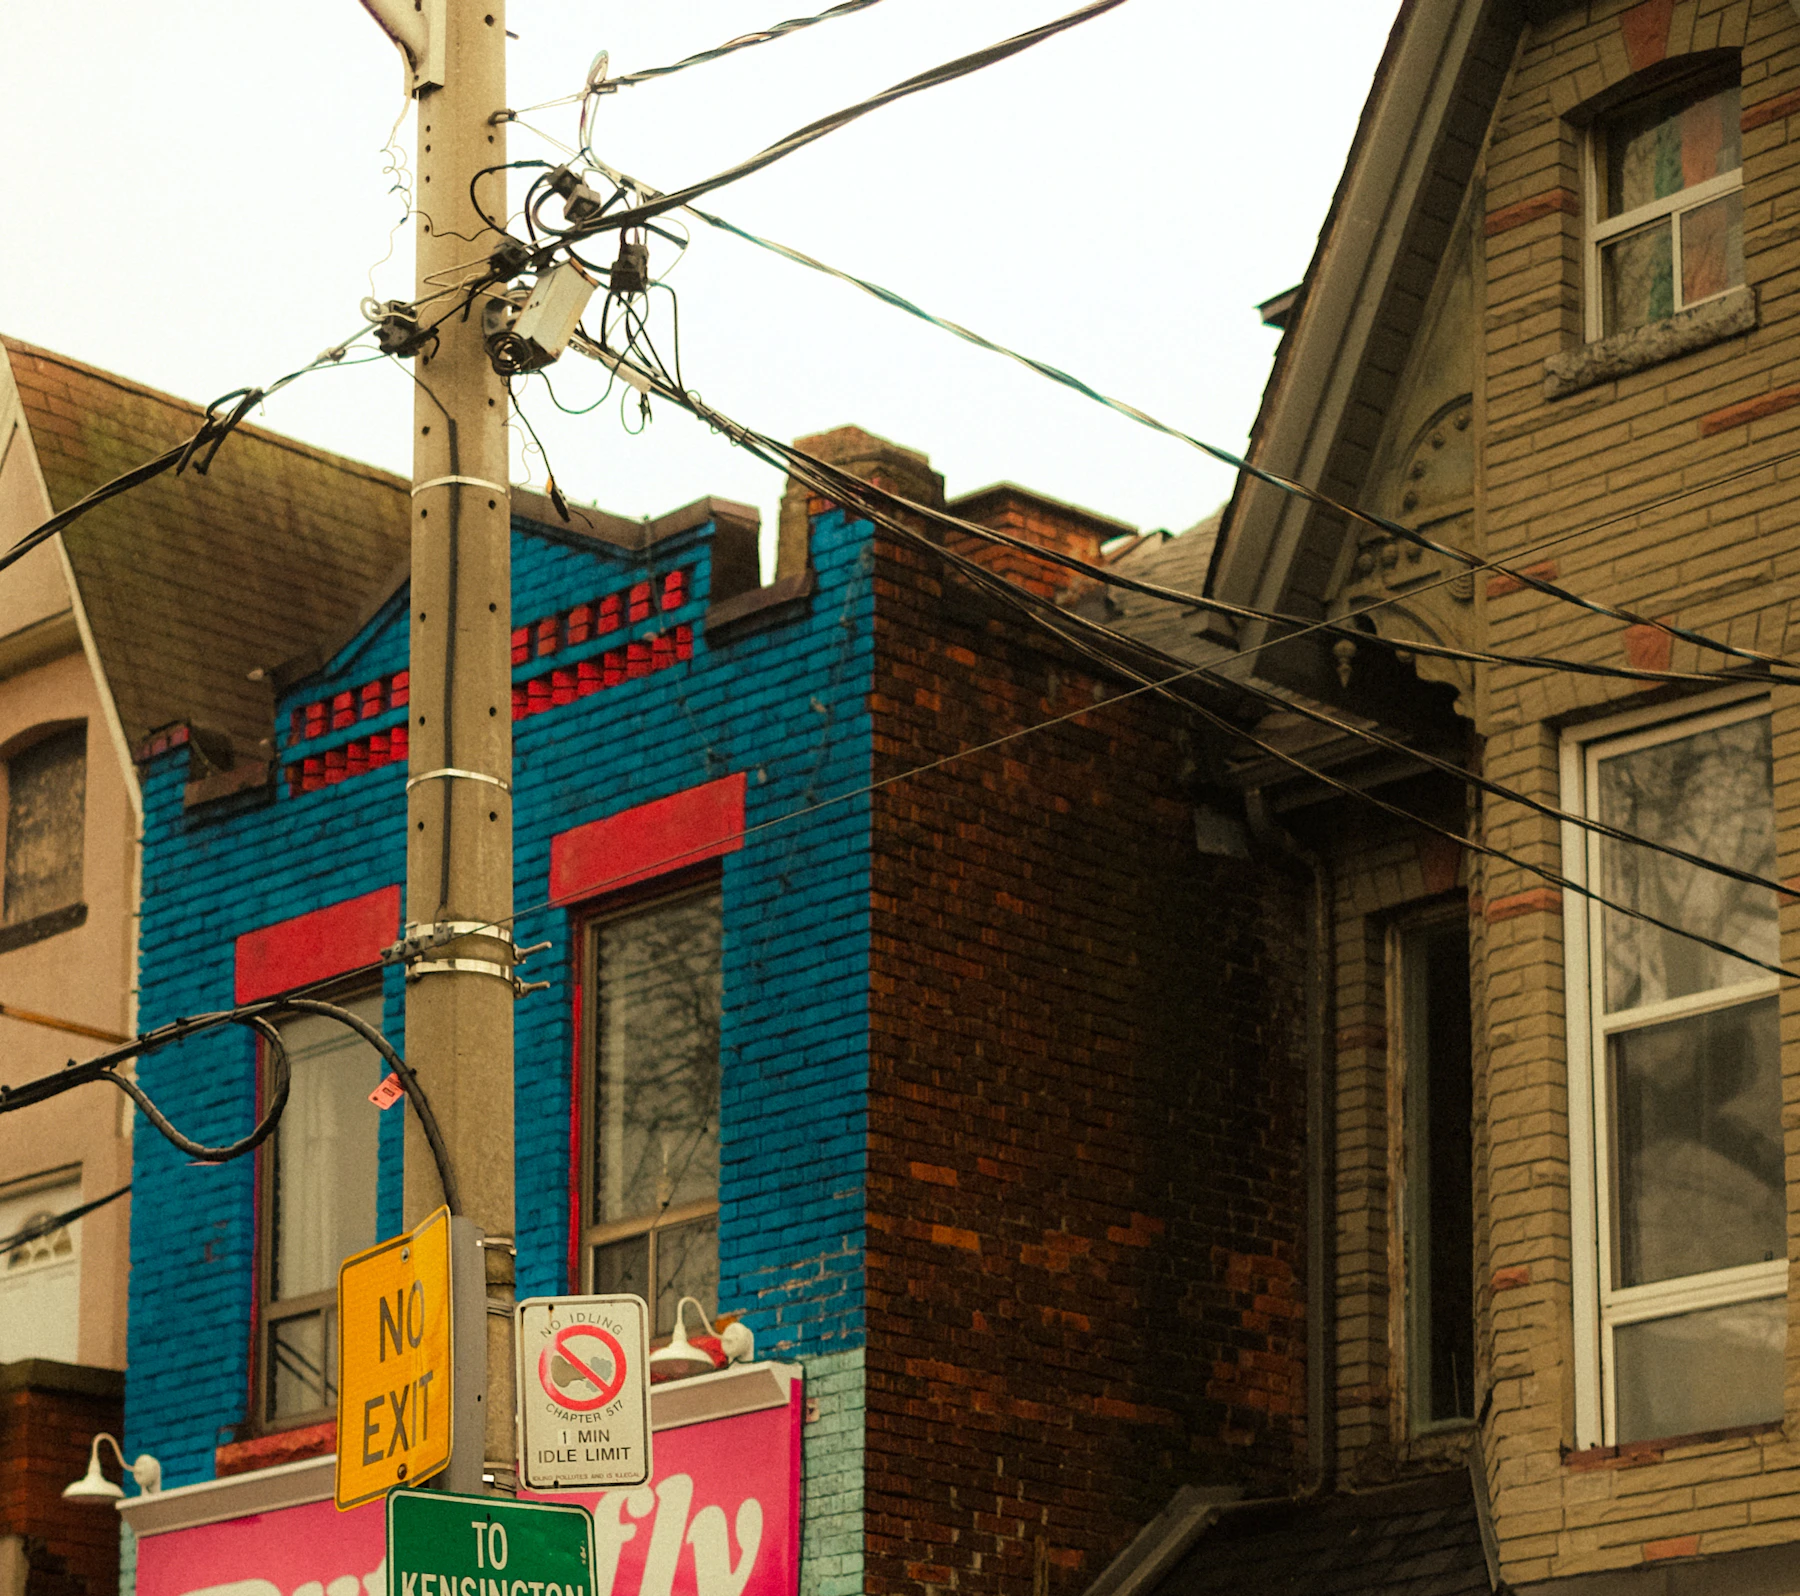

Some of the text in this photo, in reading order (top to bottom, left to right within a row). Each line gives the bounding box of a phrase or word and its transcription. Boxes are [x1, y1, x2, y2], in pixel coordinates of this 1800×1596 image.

[379, 1279, 425, 1363] NO
[540, 1312, 623, 1339] NO IDLING
[363, 1370, 434, 1467] EXIT
[545, 1399, 624, 1424] CHAPTER 517
[562, 1429, 611, 1445] 1 MIN
[538, 1446, 631, 1464] IDLE LIMIT
[555, 1473, 588, 1481] POLLUTES
[471, 1521, 508, 1570] TO
